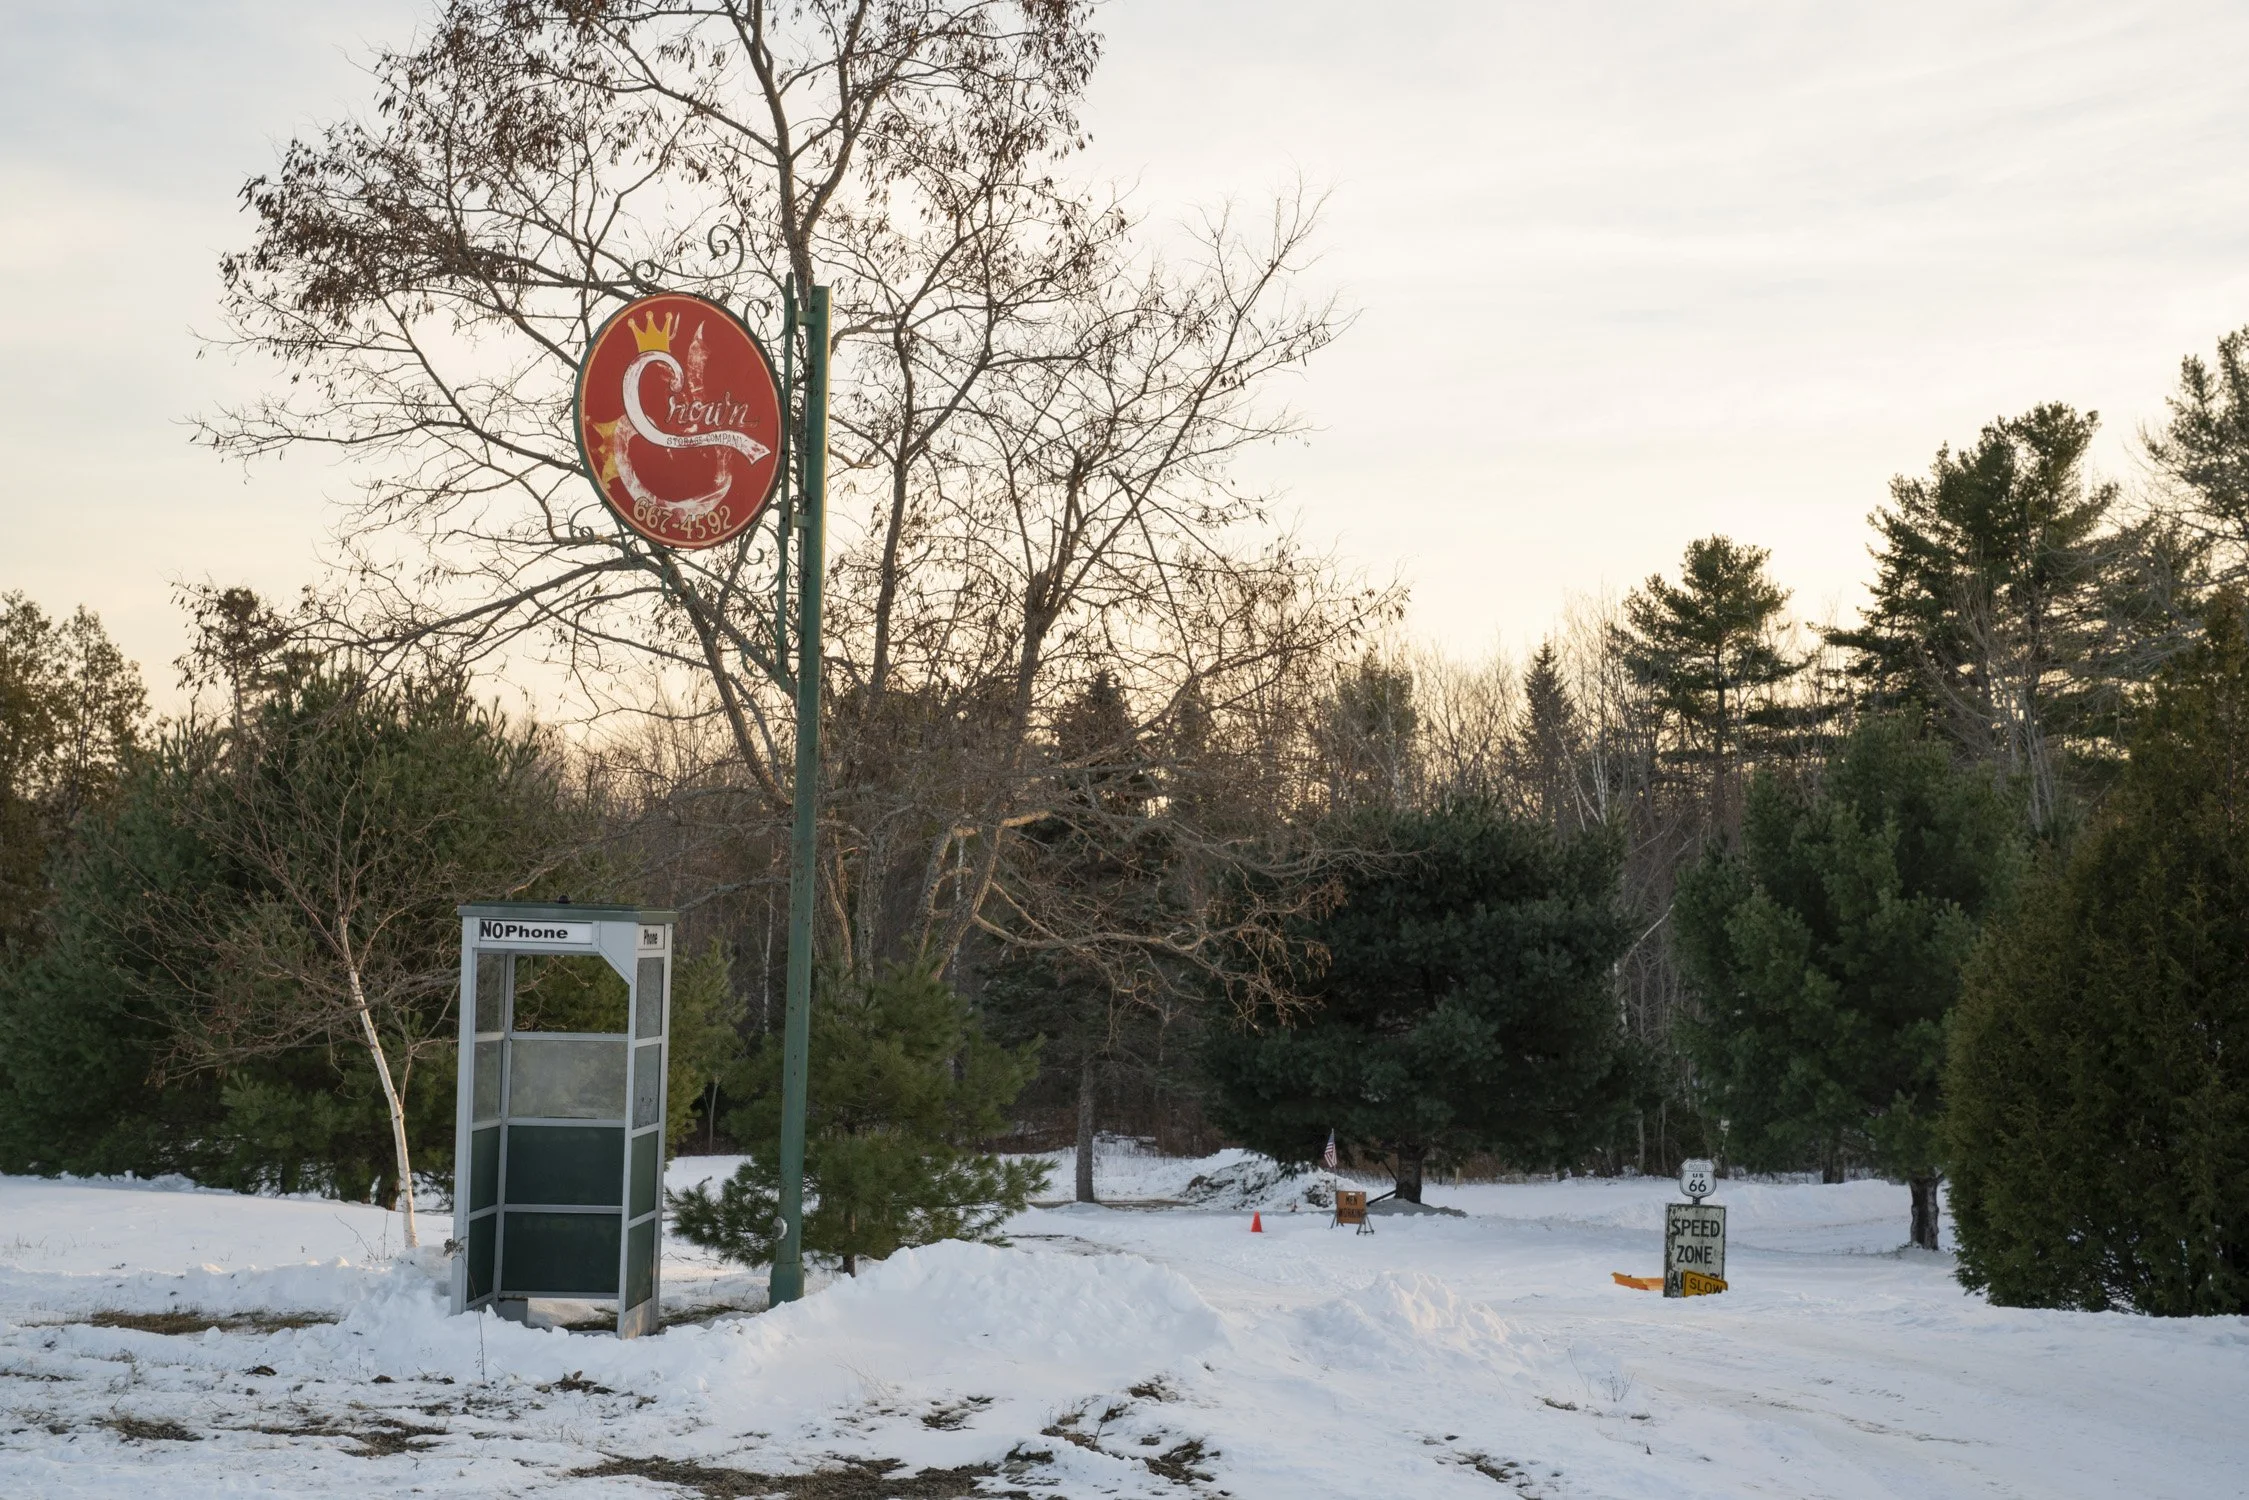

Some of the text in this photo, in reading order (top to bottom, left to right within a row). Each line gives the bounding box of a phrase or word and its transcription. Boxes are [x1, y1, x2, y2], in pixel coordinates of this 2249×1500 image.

[666, 435, 703, 447] STORAGE
[633, 496, 733, 540] 667-4592
[643, 929, 658, 946] Phone
[1688, 1179, 1707, 1193] 66
[1671, 1218, 1721, 1238] SPEED
[1676, 1245, 1713, 1264] ZONE
[1689, 1277, 1723, 1294] SLOW
